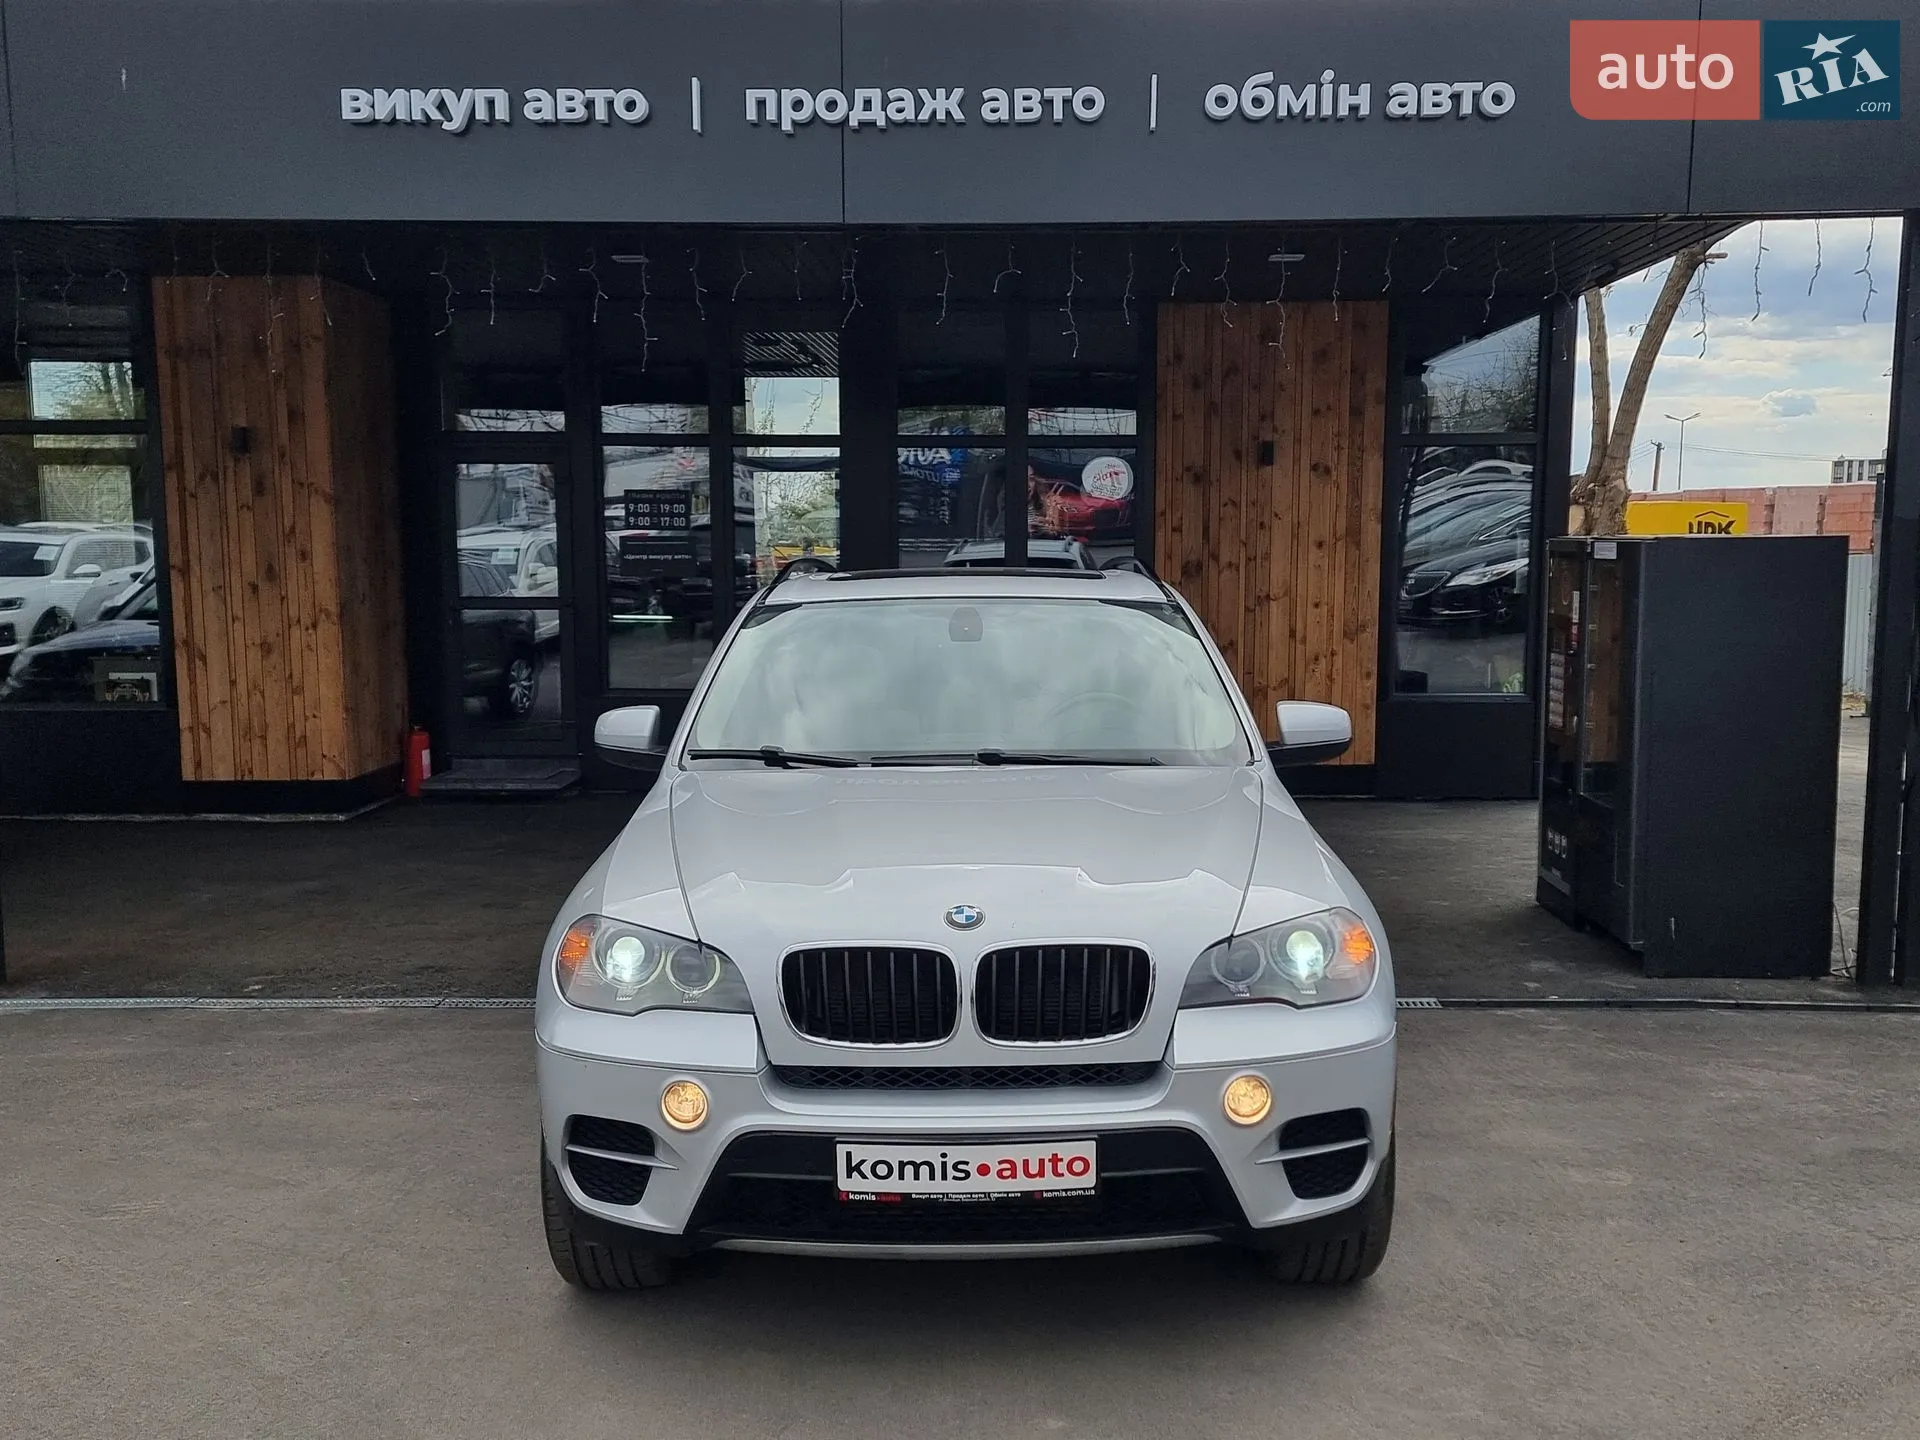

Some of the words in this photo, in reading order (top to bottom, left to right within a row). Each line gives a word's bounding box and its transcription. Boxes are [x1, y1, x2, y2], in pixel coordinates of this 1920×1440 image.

[341, 88, 510, 132] викуп
[523, 88, 650, 124] авто
[745, 87, 967, 134] продаж
[980, 86, 1106, 123] авто
[1204, 69, 1371, 121] обмін
[1386, 81, 1517, 118] авто
[629, 503, 650, 513] 9:00
[660, 504, 686, 513] 19:00
[629, 517, 650, 526] 9:00
[660, 517, 686, 526] 17:00
